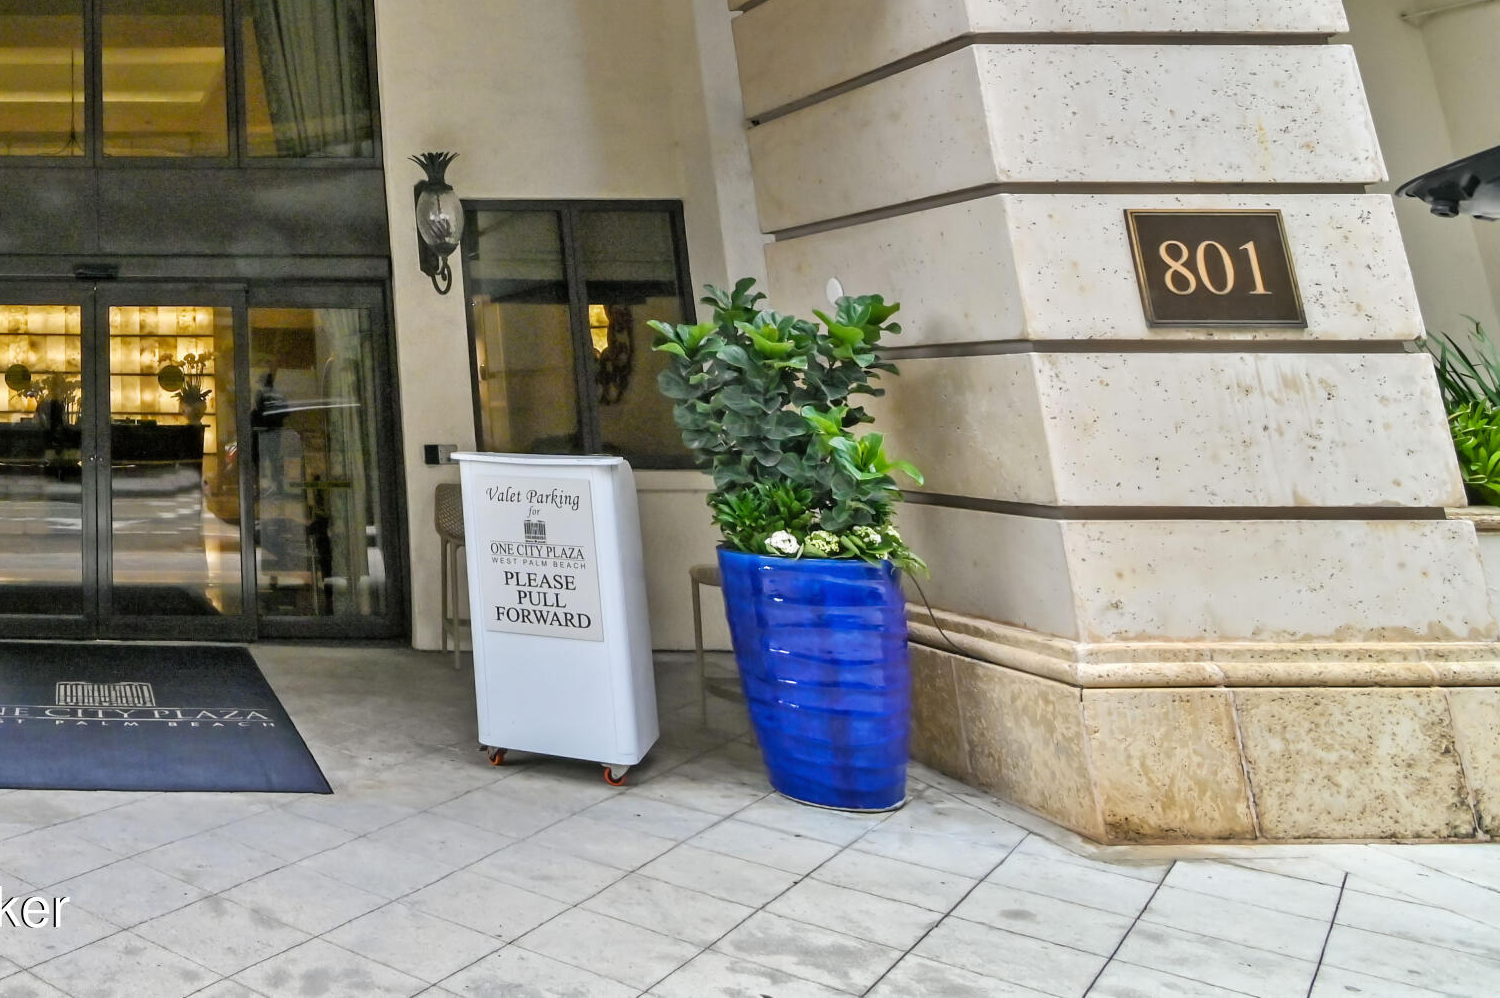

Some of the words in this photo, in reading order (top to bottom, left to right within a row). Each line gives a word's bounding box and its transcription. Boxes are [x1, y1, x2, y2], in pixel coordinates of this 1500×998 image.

[1159, 240, 1273, 295] 801
[486, 486, 521, 503] Valet
[526, 488, 580, 510] Parking
[527, 506, 540, 518] for
[490, 543, 514, 556] ONE
[517, 544, 544, 558] CITY
[547, 546, 584, 560] PLAZA
[492, 557, 517, 565] WEST
[523, 559, 548, 567] PALM
[553, 561, 586, 570] BEACH
[503, 571, 576, 590] PLEASE
[516, 590, 567, 608] PULL
[495, 606, 591, 629] FORWARD
[44, 707, 140, 719] CITY
[153, 710, 274, 720] PLAZA
